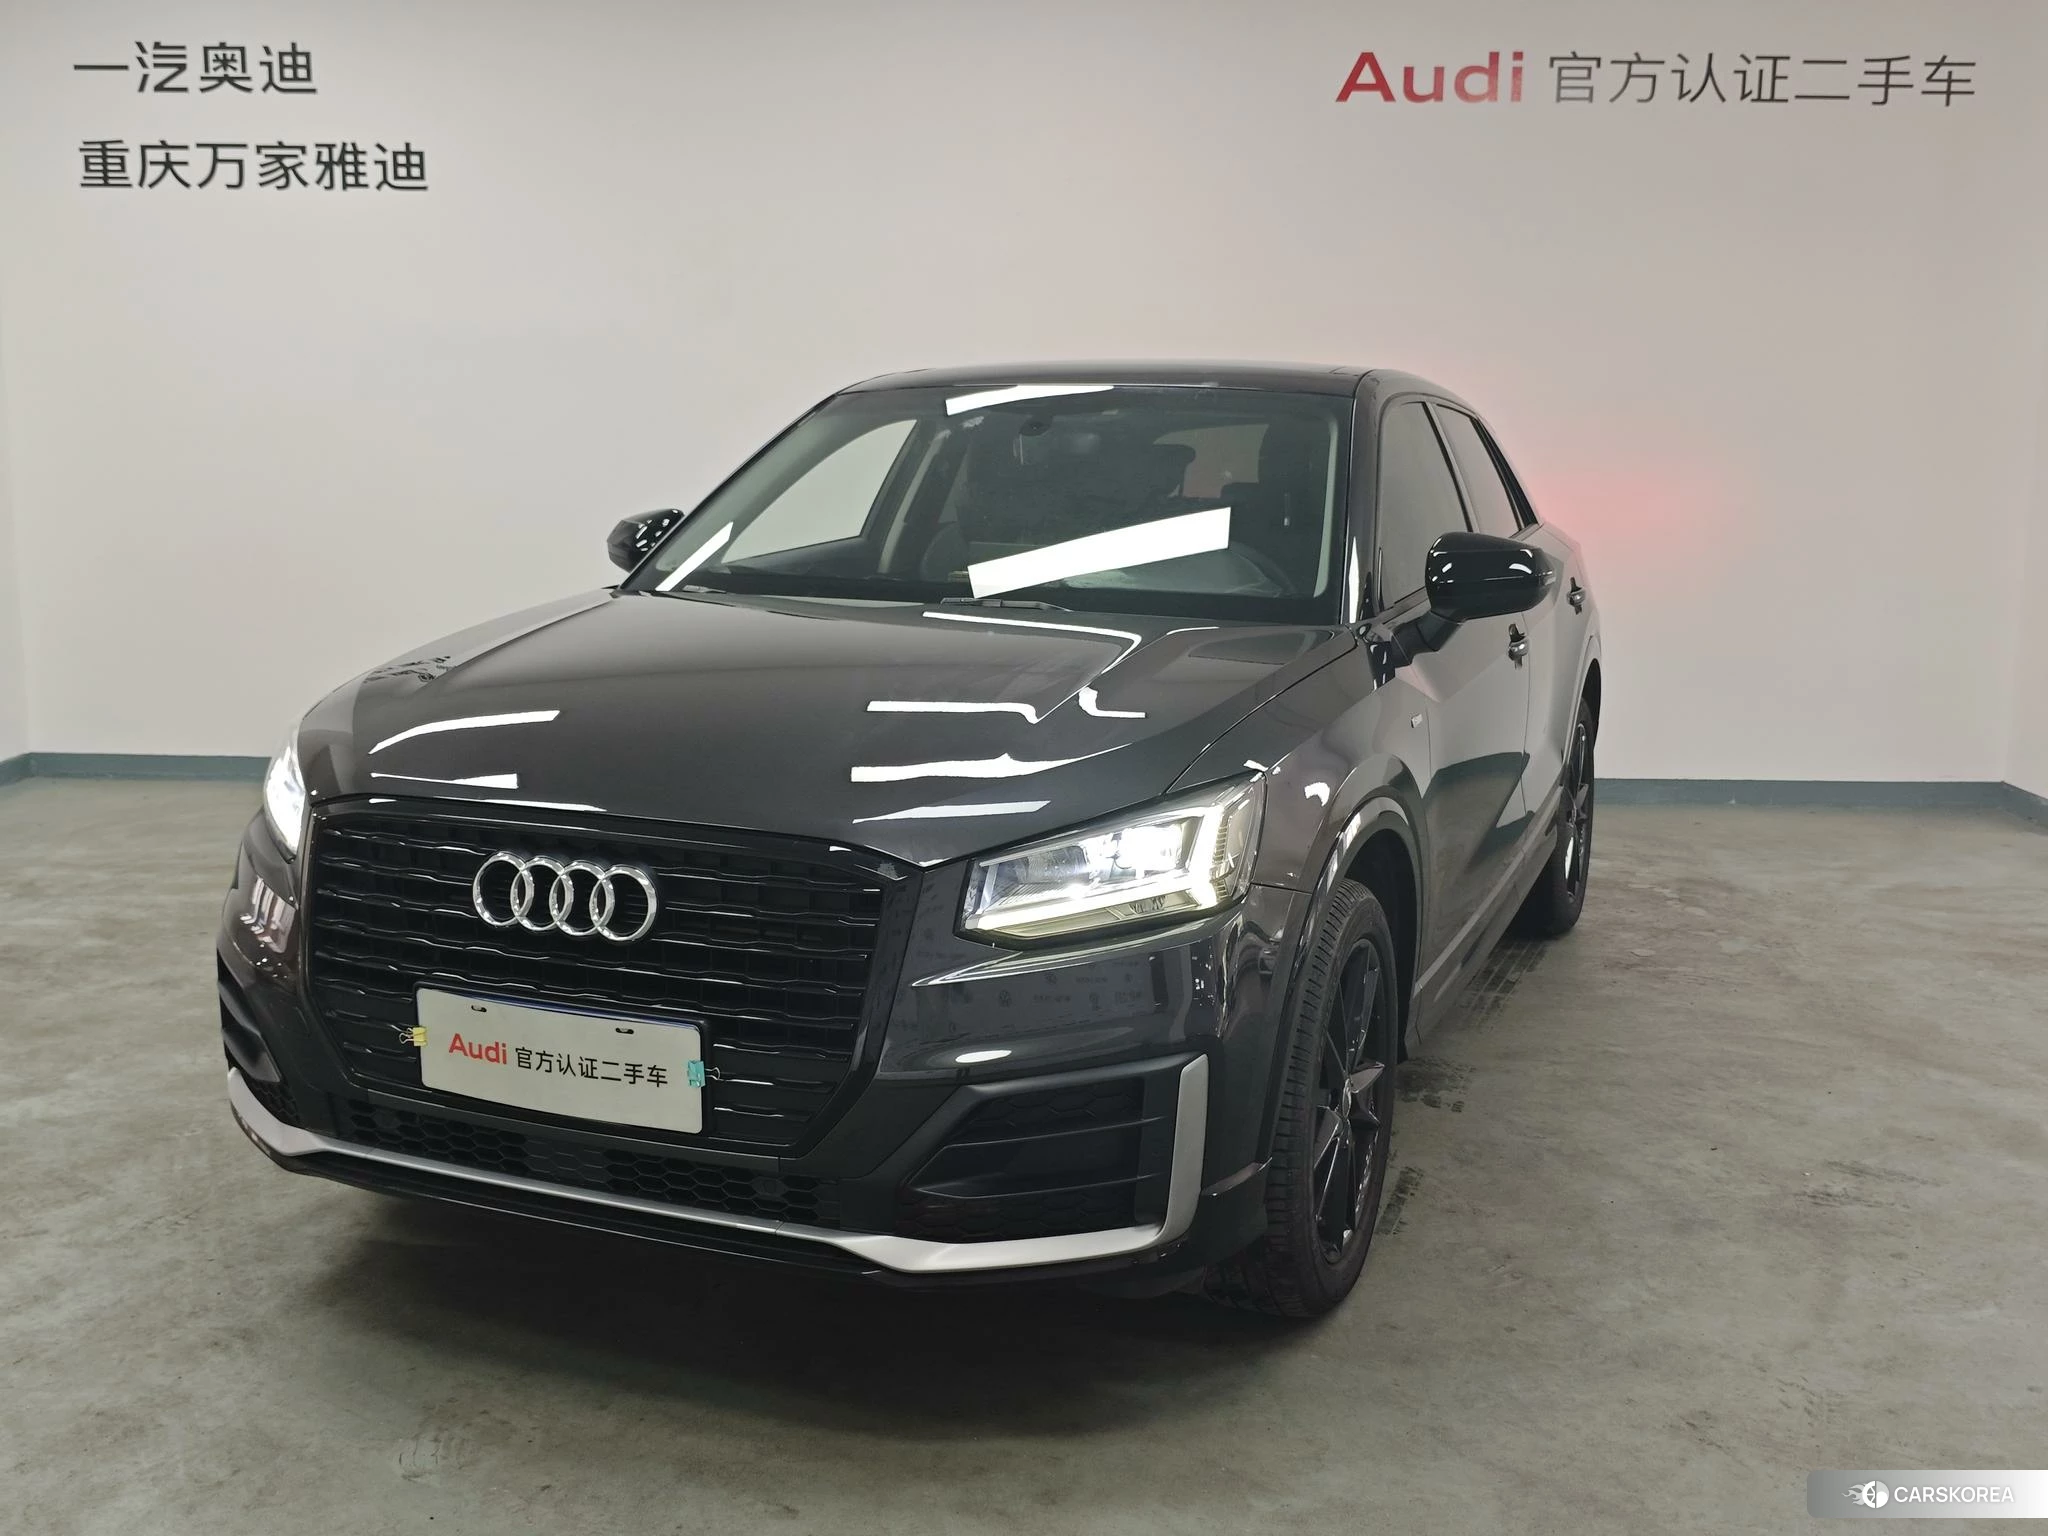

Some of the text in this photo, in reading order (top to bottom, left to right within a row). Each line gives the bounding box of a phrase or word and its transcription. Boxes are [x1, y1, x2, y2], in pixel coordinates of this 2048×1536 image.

[73, 41, 317, 94] 一汽奥迪
[1335, 51, 1977, 106] Audi 官方认证二手车
[79, 139, 428, 191] 重庆万家雅迪
[449, 1033, 668, 1087] Audi 官方认证二手车
